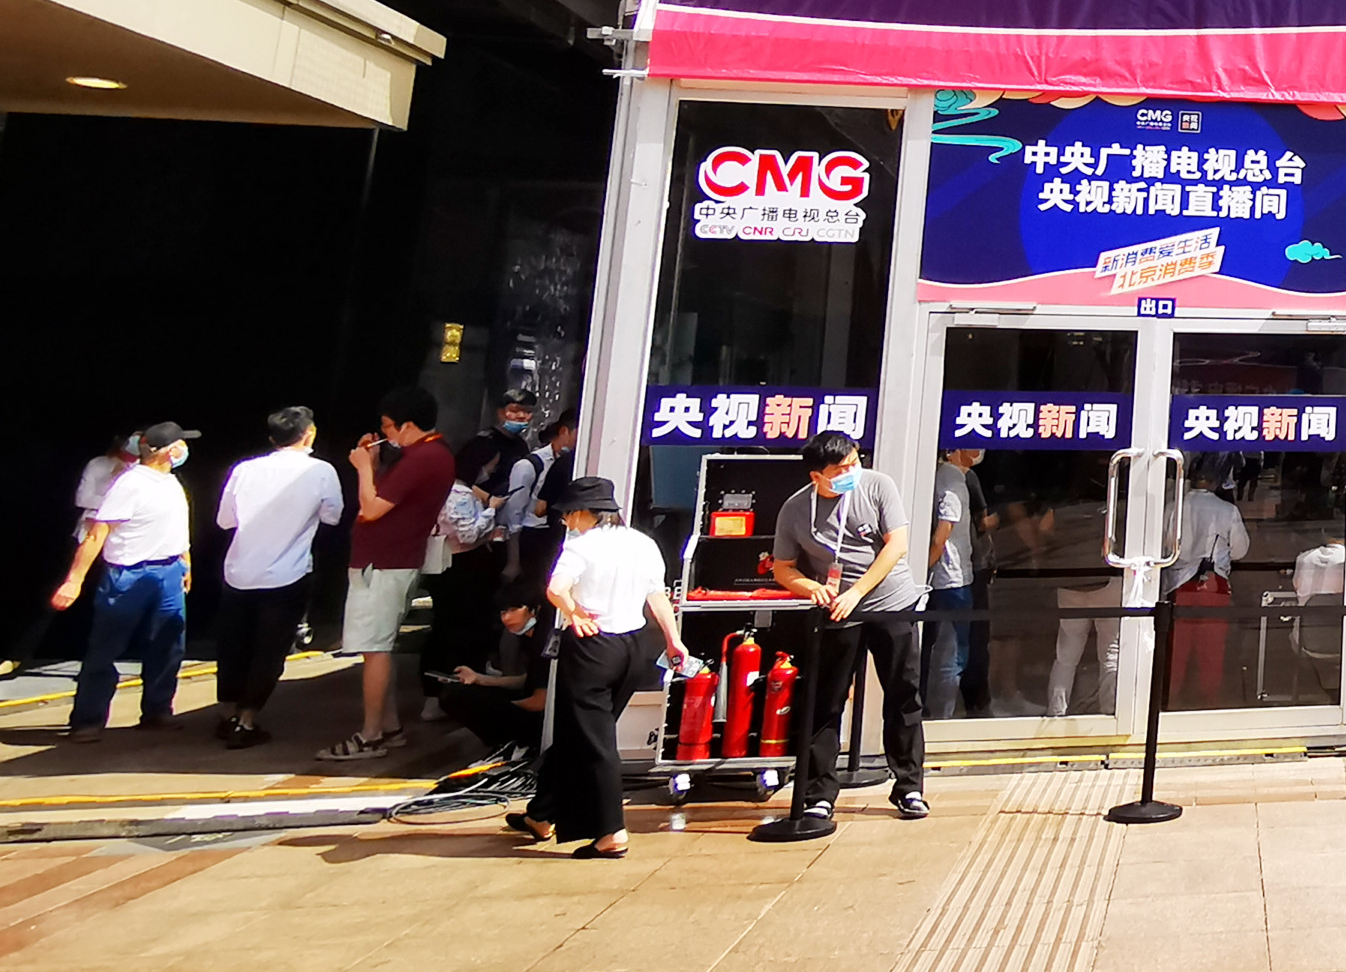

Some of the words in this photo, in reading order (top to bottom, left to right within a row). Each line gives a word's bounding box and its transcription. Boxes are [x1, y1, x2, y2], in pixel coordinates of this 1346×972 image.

[1137, 109, 1173, 122] CMG
[704, 151, 865, 201] CMG
[1024, 140, 1306, 185] 中央广播电视总台
[699, 205, 862, 224] 中央广播电视总台
[1037, 178, 1287, 220] 央视新闻直播间
[700, 224, 736, 235] CCTV
[742, 226, 774, 236] CNR
[817, 228, 856, 239] CGTN
[1101, 233, 1214, 274] 新消费爱生活
[1118, 252, 1218, 290] 北京消费季
[1140, 299, 1173, 315] 出口
[651, 393, 868, 440] 央视新闻
[954, 402, 1119, 439] 央视新闻
[1183, 405, 1338, 441] 央视新闻
